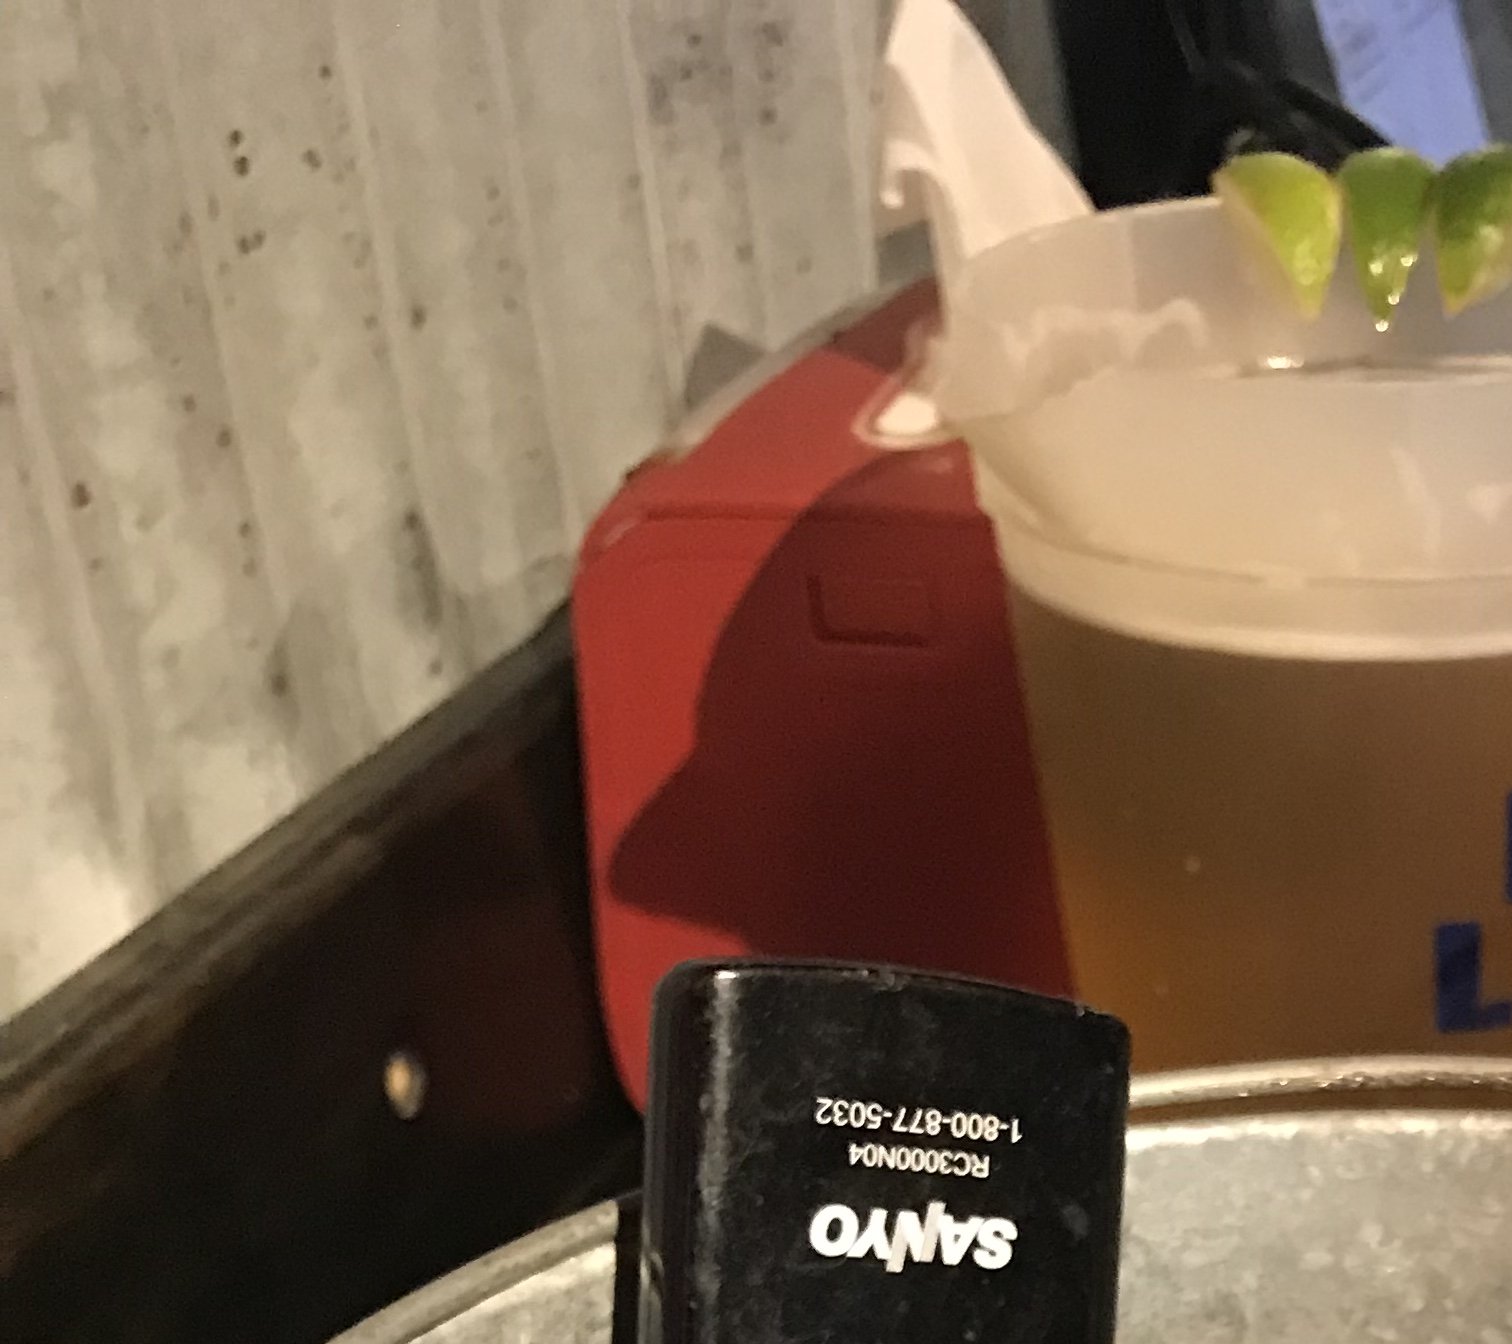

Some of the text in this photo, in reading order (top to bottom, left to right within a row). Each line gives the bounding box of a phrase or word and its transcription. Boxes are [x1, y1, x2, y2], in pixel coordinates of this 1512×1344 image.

[813, 1095, 1023, 1144] 1-800-877-5032
[848, 1141, 990, 1179] RC3000N04
[808, 1200, 1019, 1274] SANYO
